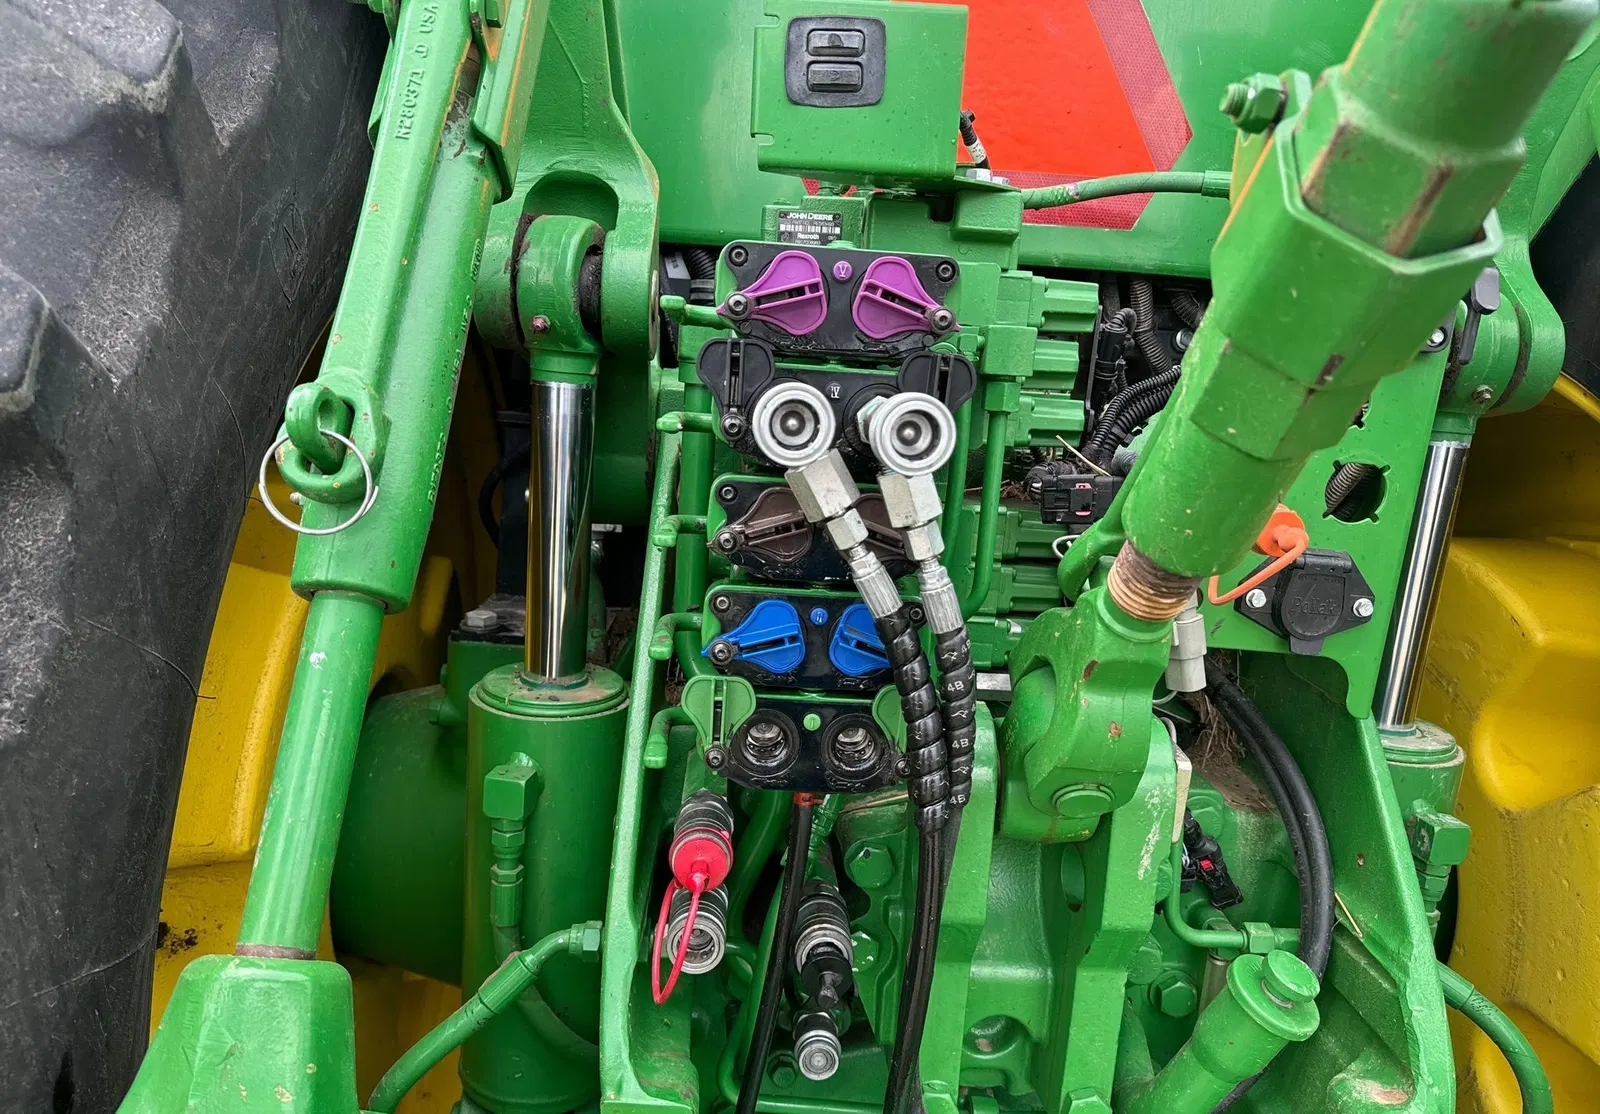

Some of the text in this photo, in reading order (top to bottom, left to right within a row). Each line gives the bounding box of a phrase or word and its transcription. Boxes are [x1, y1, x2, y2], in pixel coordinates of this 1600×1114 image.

[419, 4, 439, 34] USA
[786, 212, 833, 221] JOHN DEERE
[797, 232, 820, 240] Rexroth
[838, 264, 848, 278] V
[830, 385, 841, 399] IV
[947, 680, 965, 692] 4B
[952, 738, 969, 749] 4B
[949, 794, 966, 805] 4B
